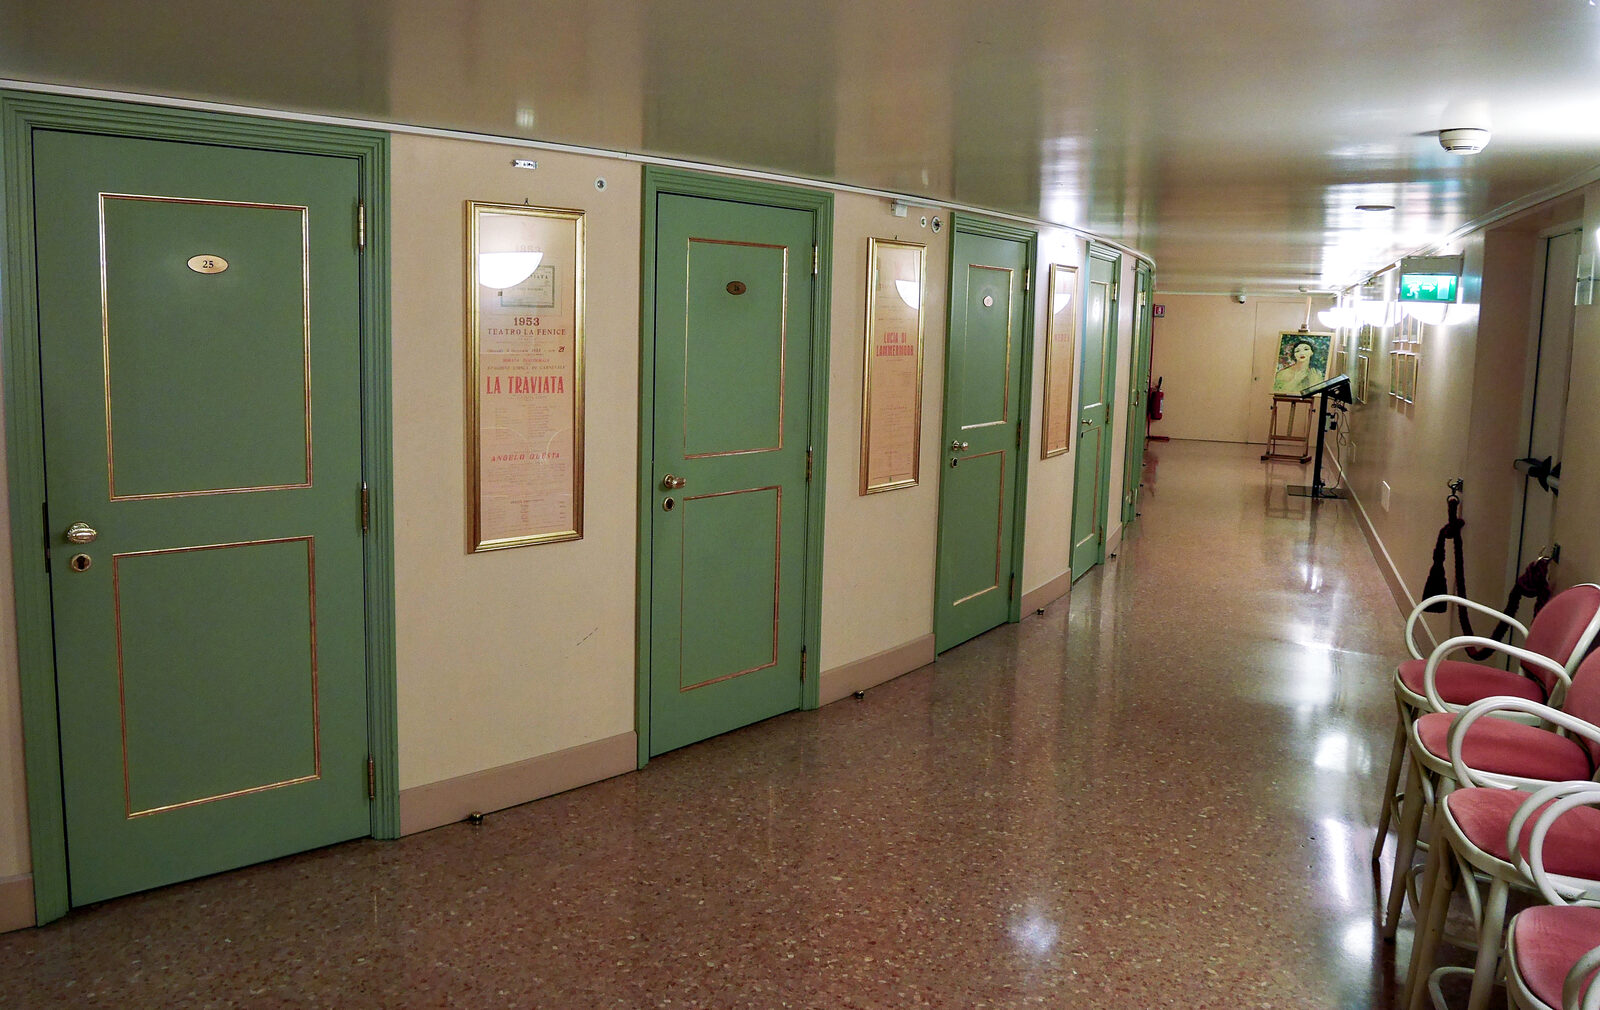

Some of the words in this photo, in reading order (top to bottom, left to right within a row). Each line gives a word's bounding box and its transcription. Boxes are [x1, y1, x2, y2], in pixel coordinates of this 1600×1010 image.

[202, 260, 214, 268] 25
[514, 316, 540, 326] 1953
[488, 328, 521, 336] TEATRO
[537, 328, 566, 336] FENICE
[884, 332, 898, 344] LUCIA
[486, 376, 502, 395] LA
[508, 376, 564, 394] TRAVIATA
[492, 453, 525, 462] ANGELO
